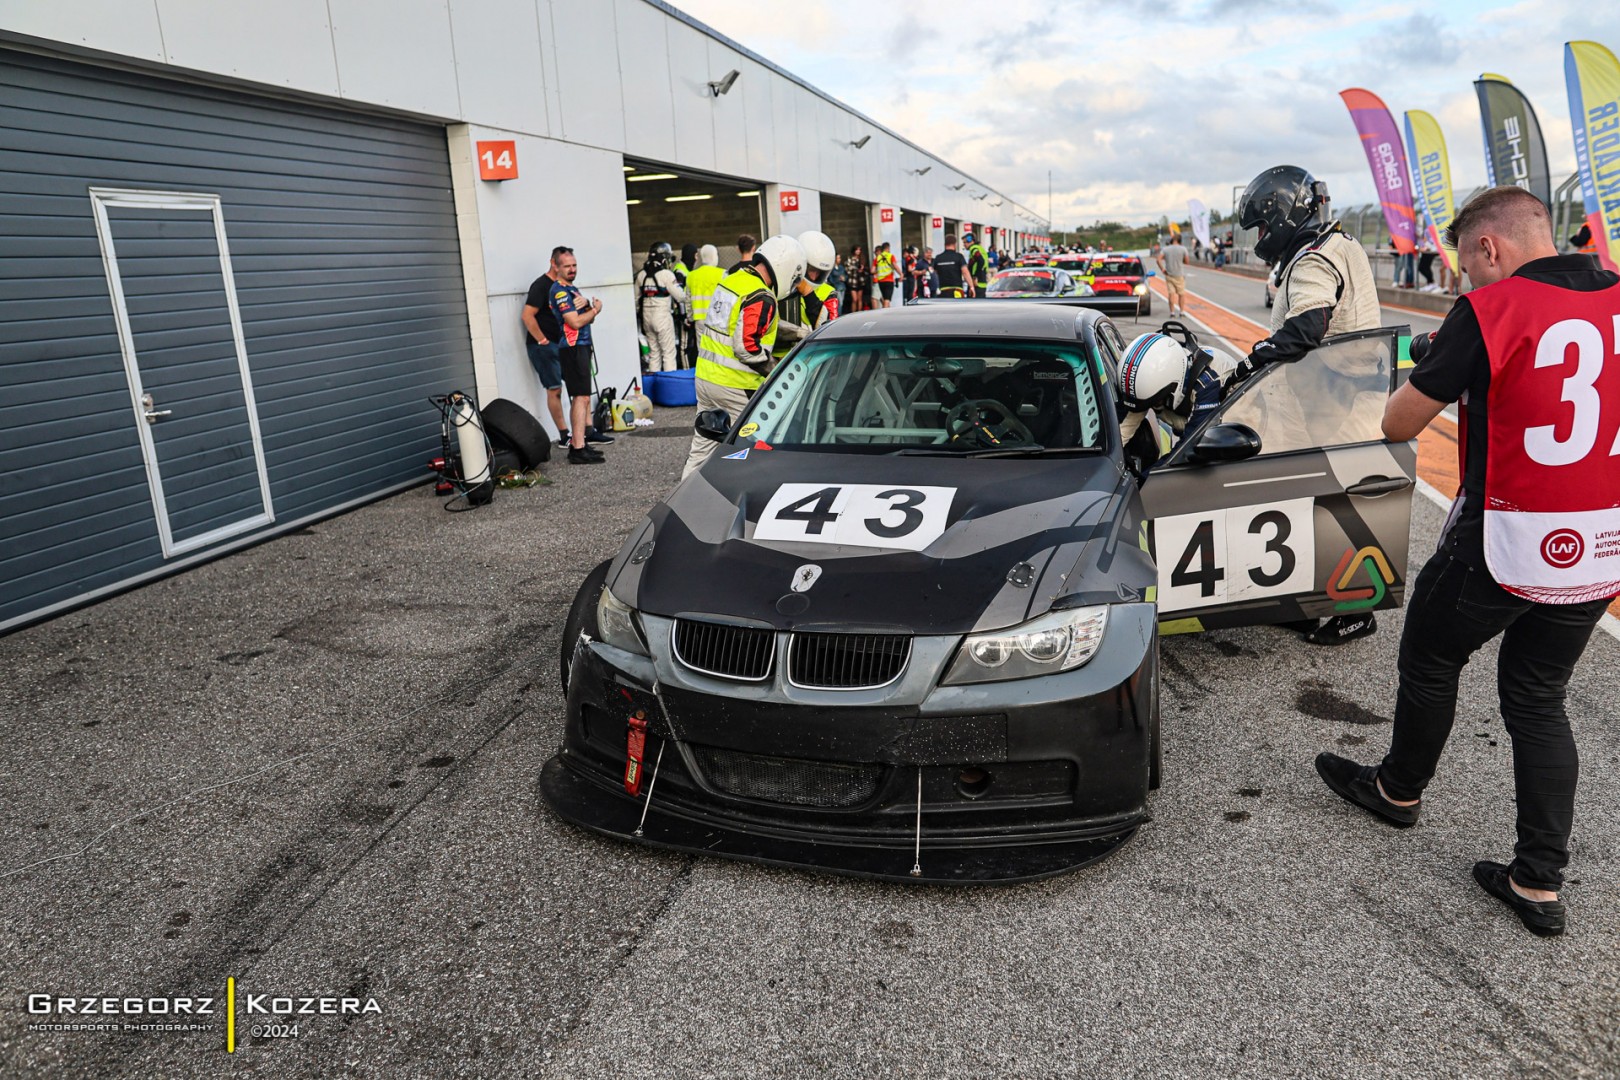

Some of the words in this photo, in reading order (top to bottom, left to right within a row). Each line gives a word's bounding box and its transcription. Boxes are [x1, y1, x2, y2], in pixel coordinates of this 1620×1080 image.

[481, 151, 512, 170] 14
[781, 196, 797, 207] 13
[882, 211, 892, 219] 12
[1128, 365, 1137, 396] RACING
[775, 487, 926, 538] 43
[1170, 510, 1296, 598] 43
[1551, 541, 1576, 554] LAF
[1594, 548, 1620, 559] FEDERĀ
